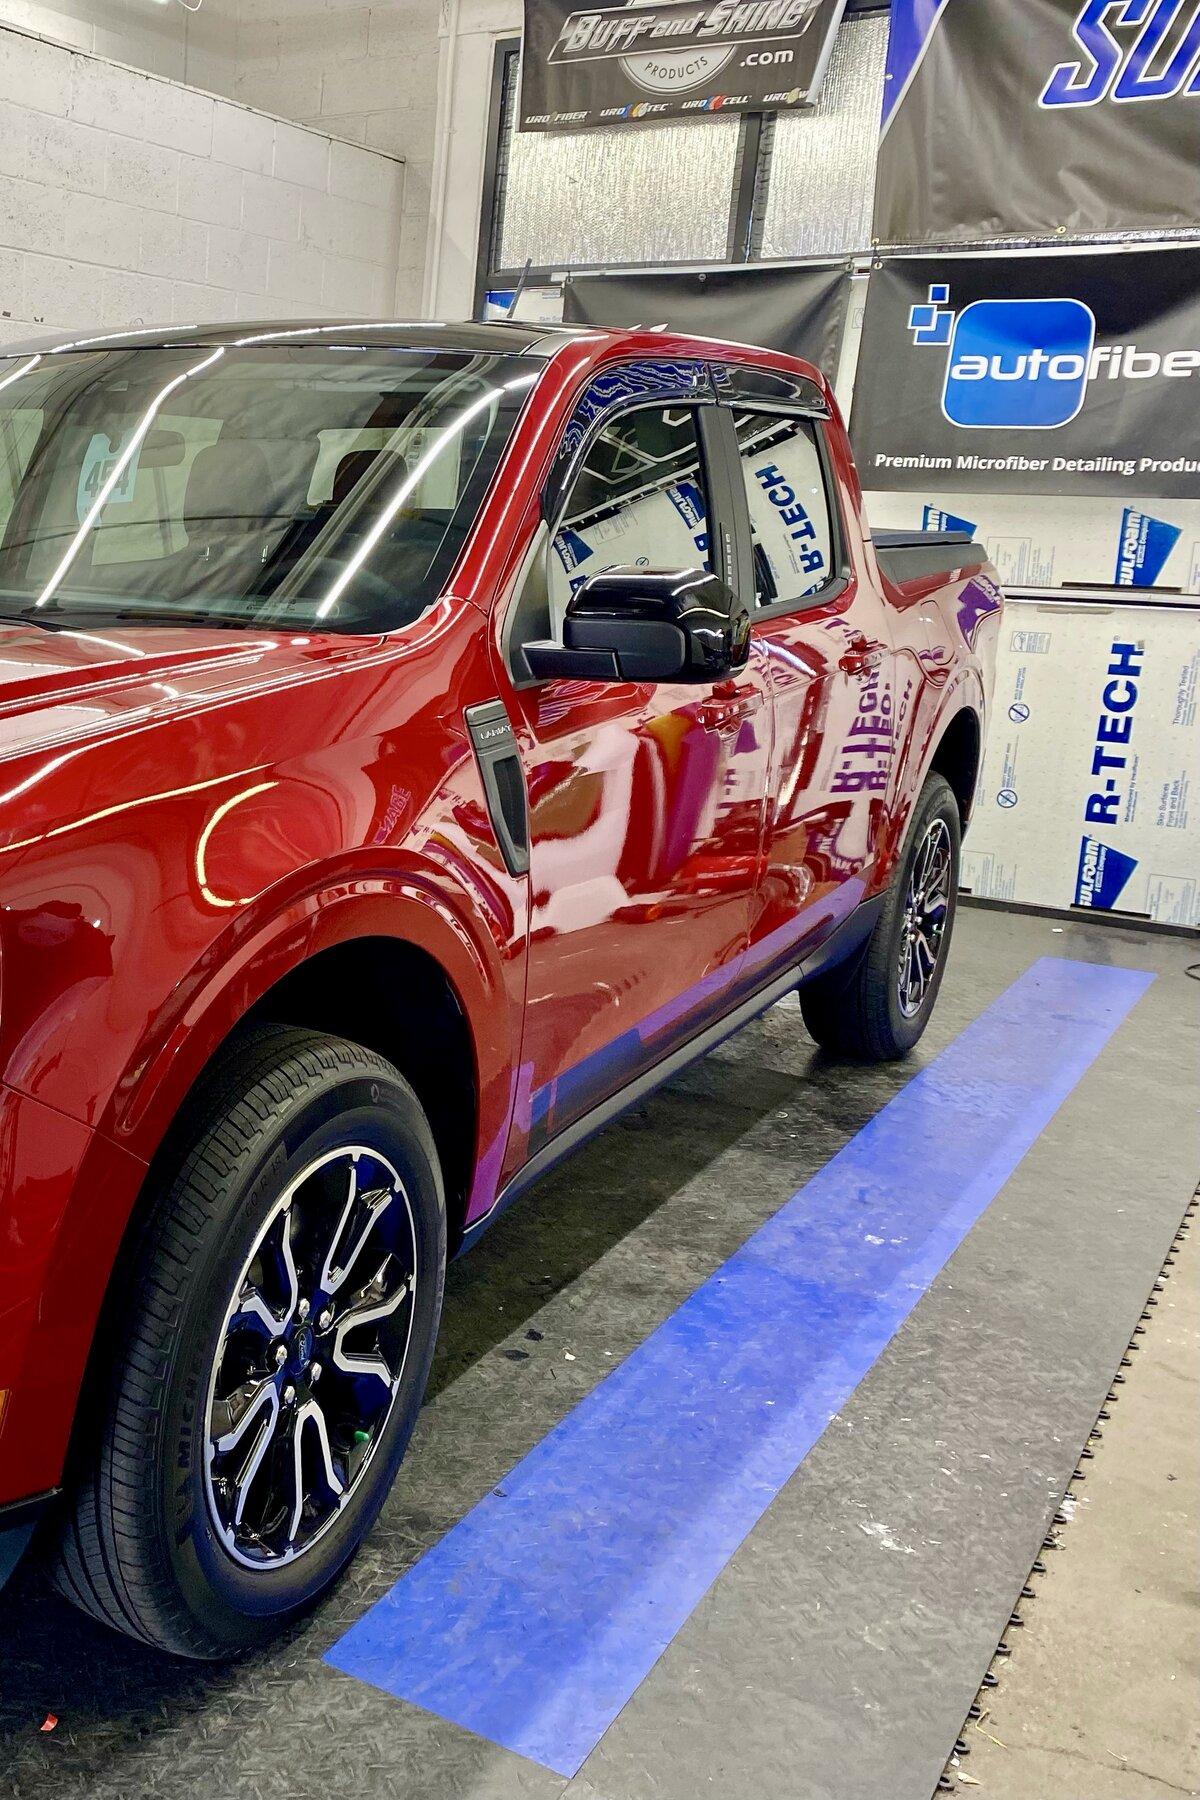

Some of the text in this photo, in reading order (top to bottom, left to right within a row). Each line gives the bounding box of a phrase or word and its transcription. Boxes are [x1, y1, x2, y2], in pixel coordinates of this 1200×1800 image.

[650, 12, 704, 37] and
[644, 55, 709, 80] PRODUCTS
[739, 49, 794, 67] .com
[951, 345, 1200, 381] autofibe
[875, 453, 952, 470] Premium
[956, 454, 1049, 471] Microfiber
[1052, 456, 1136, 476] Detailing
[1172, 688, 1187, 725] Thoroughly
[1085, 640, 1144, 825] R-TECH
